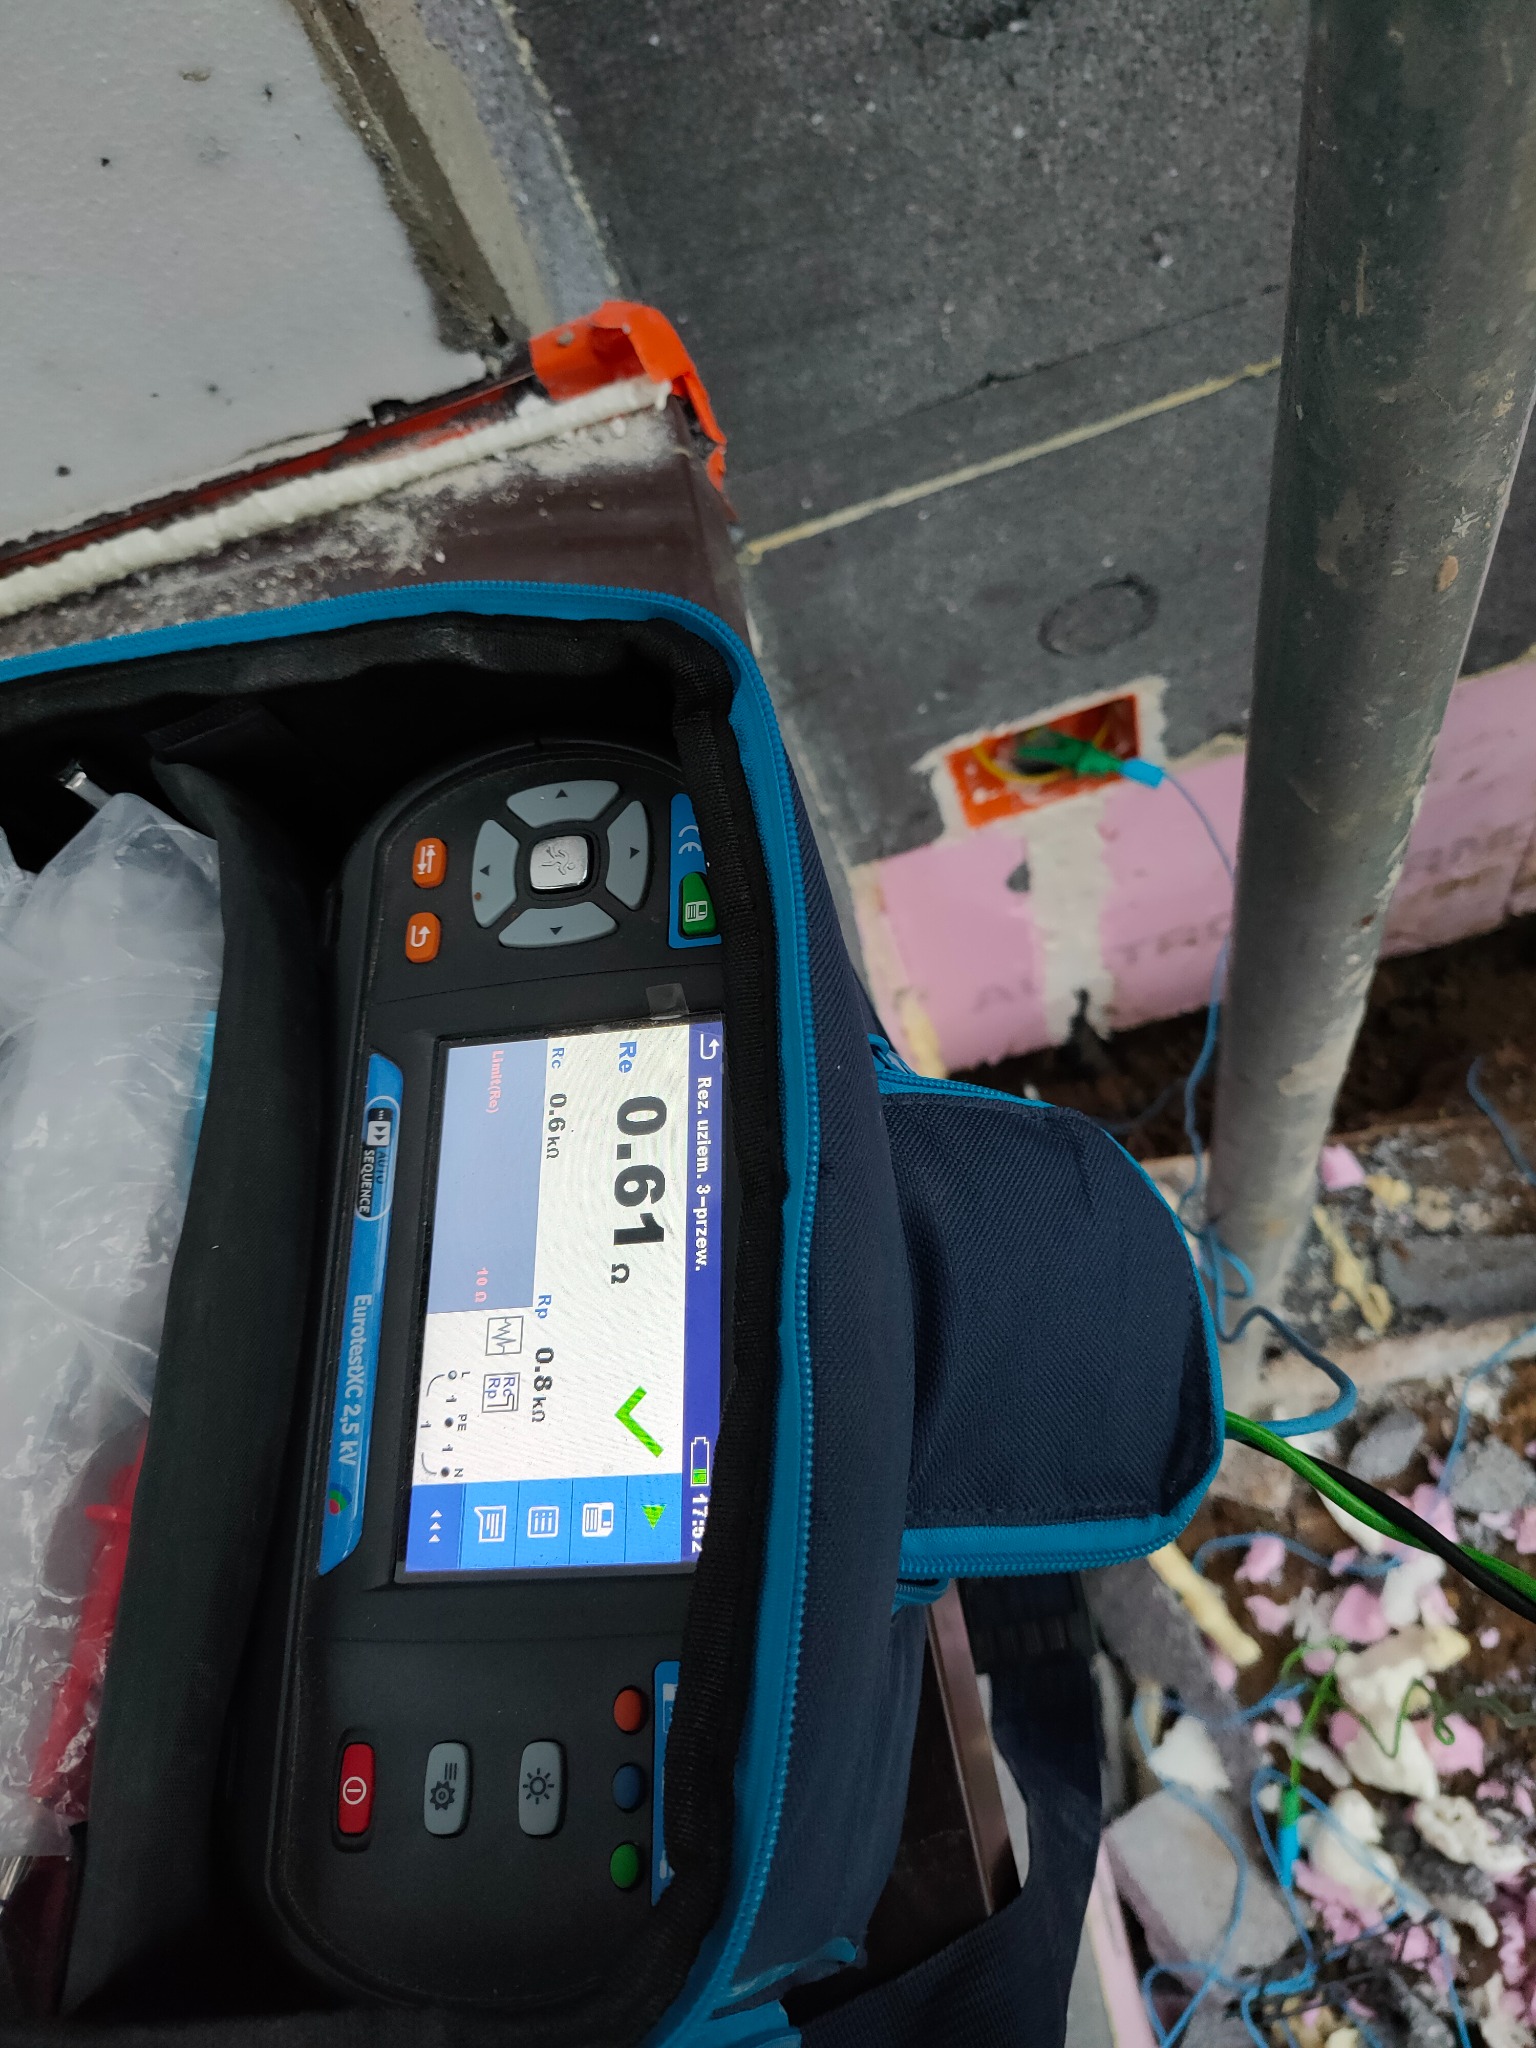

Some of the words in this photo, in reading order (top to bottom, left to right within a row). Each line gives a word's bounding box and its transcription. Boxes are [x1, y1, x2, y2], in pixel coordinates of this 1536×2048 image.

[551, 1047, 565, 1069] Rc
[618, 1041, 637, 1073] Re
[485, 1050, 504, 1113] Limit(Re)
[697, 1076, 712, 1115] Rez.
[548, 1093, 567, 1132] 0.6
[696, 1119, 711, 1179] uziem.
[359, 1149, 375, 1214] SEQUENCE
[376, 1150, 390, 1185] AUTO
[613, 1095, 667, 1246] 0.61
[693, 1184, 712, 1271] 3-przew.
[476, 1267, 489, 1286] 10
[610, 1263, 630, 1284] Ω
[535, 1294, 552, 1319] Rp
[344, 1294, 372, 1398] EurotestXC
[533, 1346, 554, 1391] 0.8
[485, 1378, 500, 1399] Rp
[339, 1404, 362, 1435] 2,5
[457, 1413, 467, 1431] PE
[338, 1440, 358, 1466] kV
[454, 1468, 464, 1477] N
